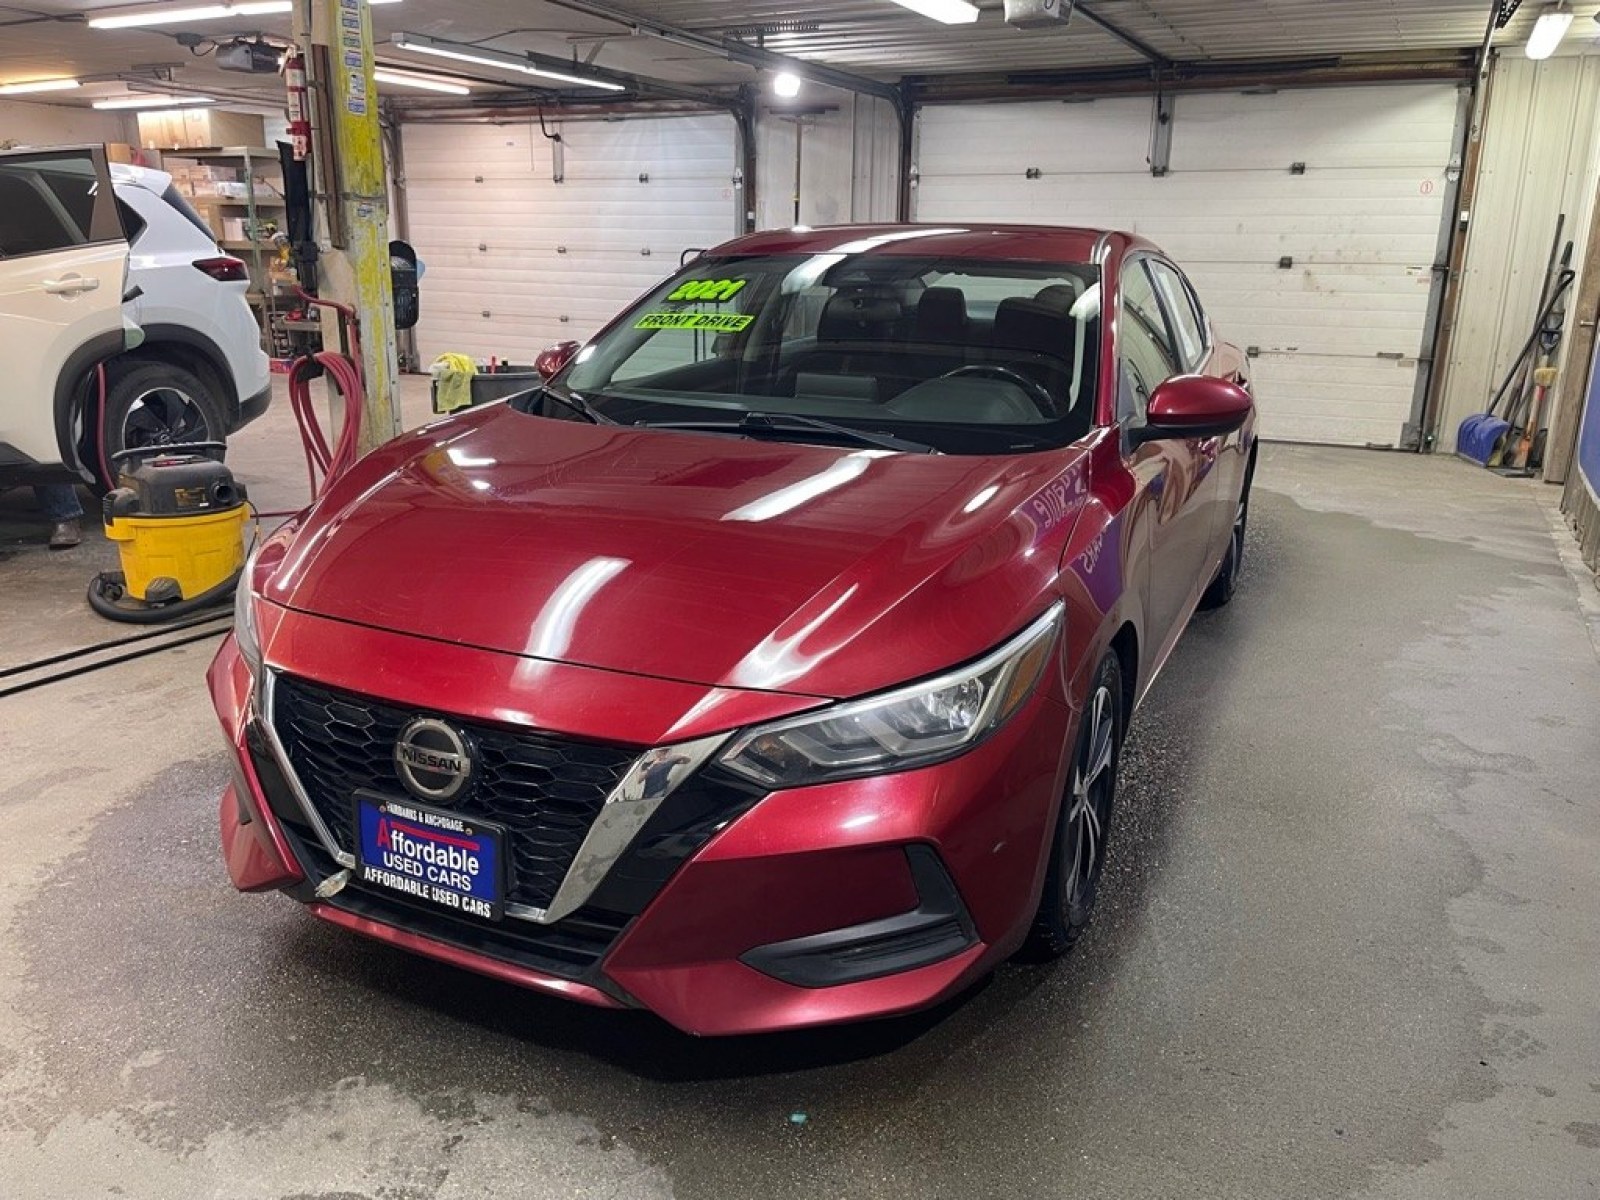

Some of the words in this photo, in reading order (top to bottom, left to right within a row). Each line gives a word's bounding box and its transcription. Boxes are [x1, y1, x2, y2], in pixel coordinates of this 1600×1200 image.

[667, 279, 747, 301] 2021
[642, 315, 696, 326] FRONT
[693, 316, 745, 328] DRIVE
[402, 746, 462, 772] NISSAN
[377, 818, 480, 876] Affordable
[383, 851, 423, 877] USED
[427, 866, 473, 892] CARS
[364, 866, 429, 899] AFFORDABLE
[432, 887, 459, 908] USED
[462, 896, 492, 918] CARS
